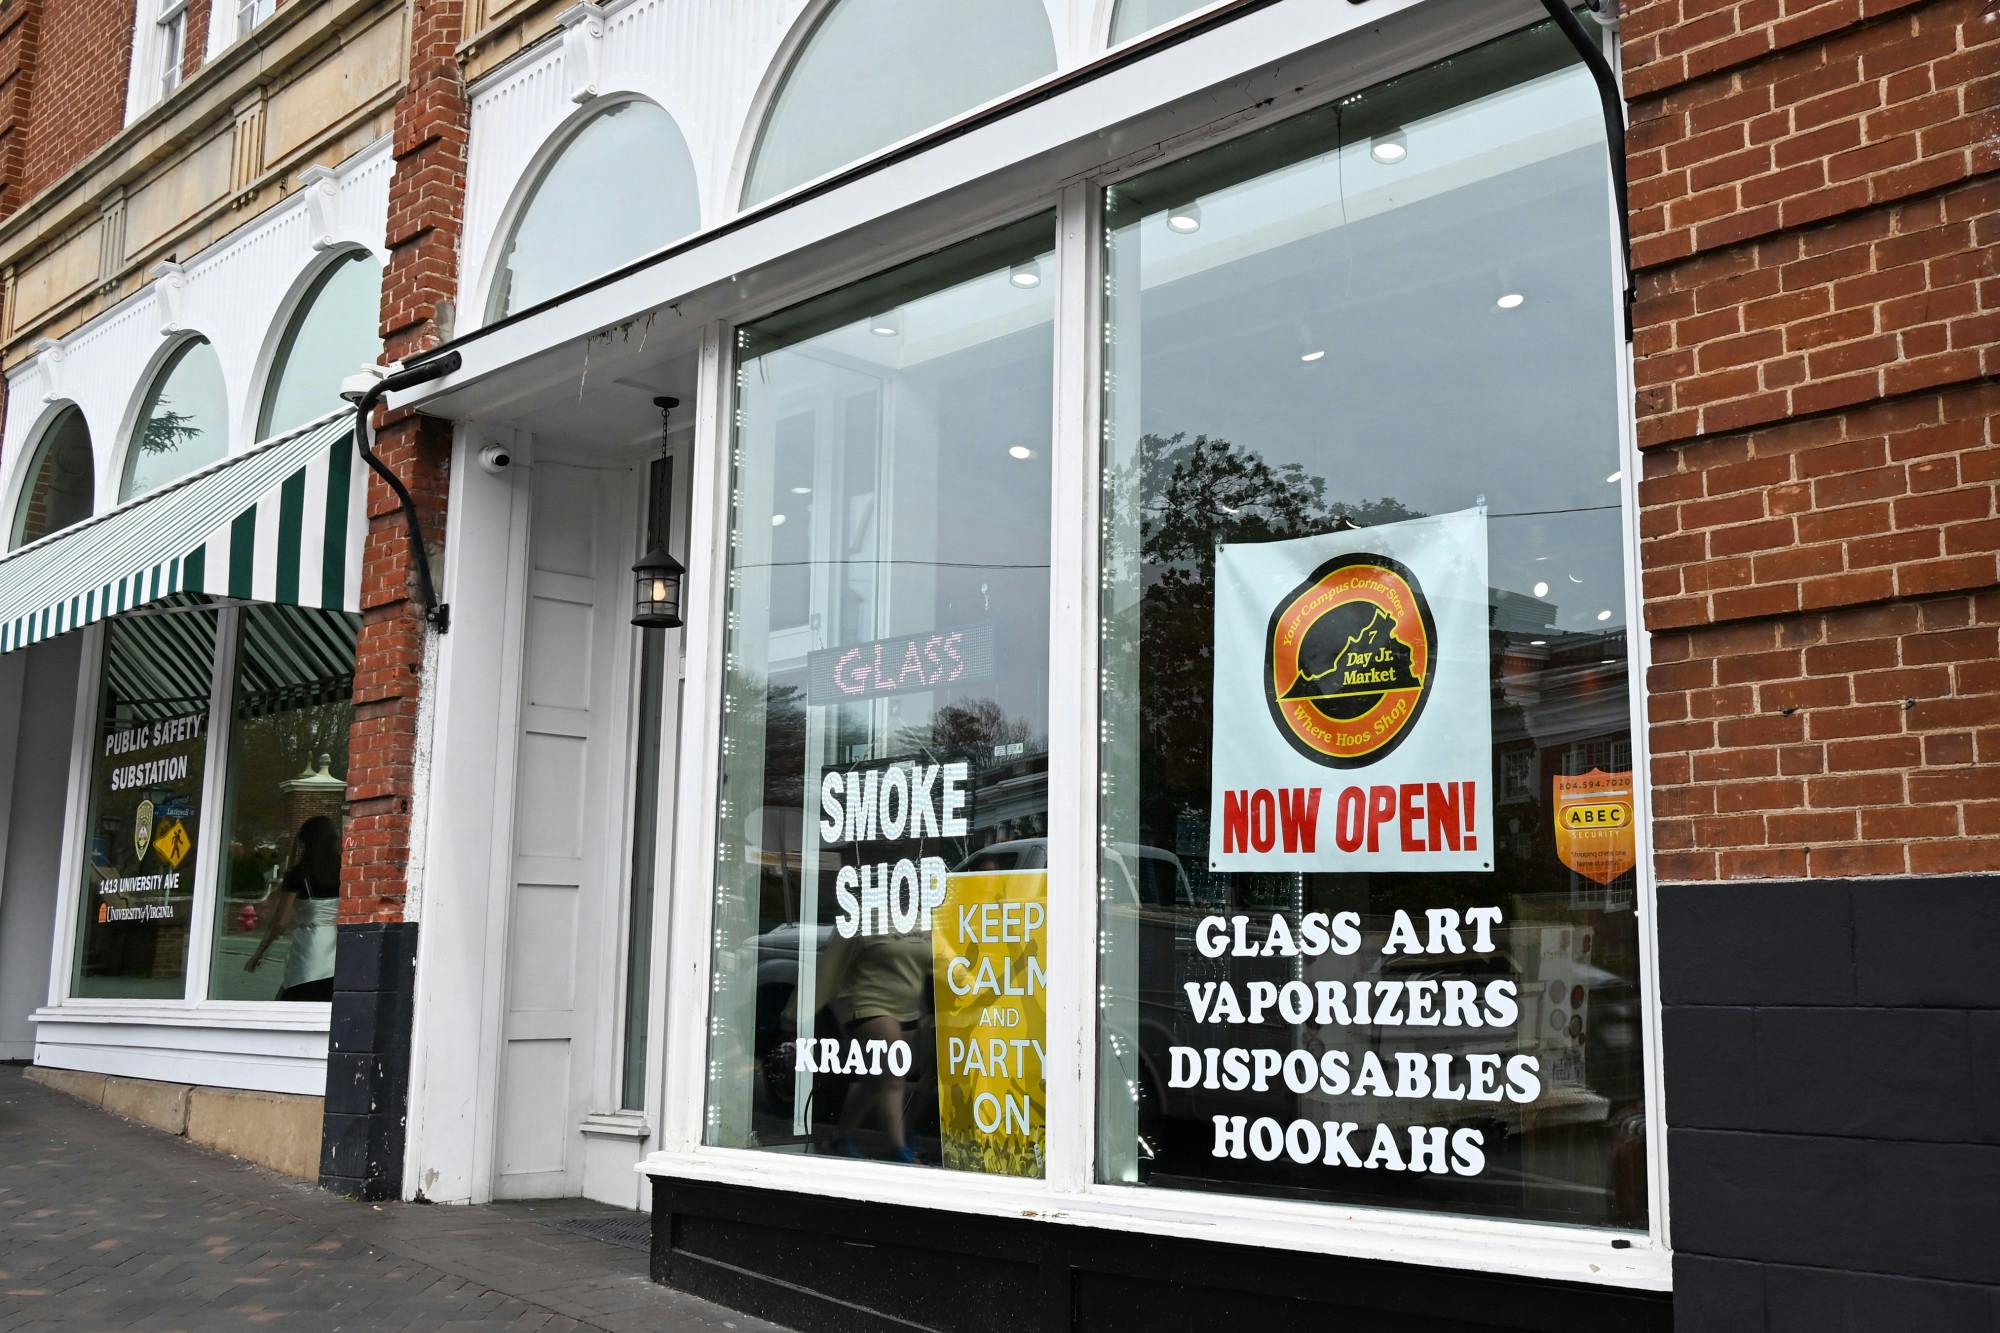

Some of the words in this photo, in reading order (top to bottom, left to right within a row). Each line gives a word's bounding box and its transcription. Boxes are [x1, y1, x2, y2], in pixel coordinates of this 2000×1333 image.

[1283, 617, 1302, 646] Your
[1302, 580, 1349, 616] Campus
[1350, 577, 1389, 594] Corner
[1386, 588, 1406, 618] Store
[1346, 652, 1372, 667] Day
[1375, 647, 1394, 662] Jr.
[1368, 630, 1378, 644] 7
[833, 631, 965, 695] GLASS
[1342, 667, 1396, 686] Market
[106, 726, 149, 757] PUBLIC
[153, 714, 202, 747] SAFETY
[1293, 705, 1332, 743] Where
[1336, 732, 1371, 747] Hoos
[1373, 698, 1407, 735] Shop
[111, 755, 188, 791] SUBSTATION
[819, 762, 968, 844] SMOKE
[1223, 787, 1322, 854] NOW
[1335, 781, 1478, 854] OPEN!
[1571, 809, 1620, 823] ABEC
[1571, 830, 1619, 839] SECURITY
[99, 879, 118, 895] 1413
[119, 874, 163, 893] UNIVERSITY
[164, 873, 179, 889] AVE
[835, 856, 948, 939] SHOP
[958, 901, 1045, 944] KEEP
[1195, 911, 1361, 958] GLASS
[1381, 906, 1502, 955] ART
[979, 1007, 1020, 1028] AND
[1183, 979, 1519, 1028] VAPORIZERS
[794, 1037, 912, 1077] KRATO
[1167, 1045, 1541, 1104] DISPOSABLES
[972, 1091, 1031, 1136] ON
[1211, 1115, 1486, 1177] HOOKAHS
